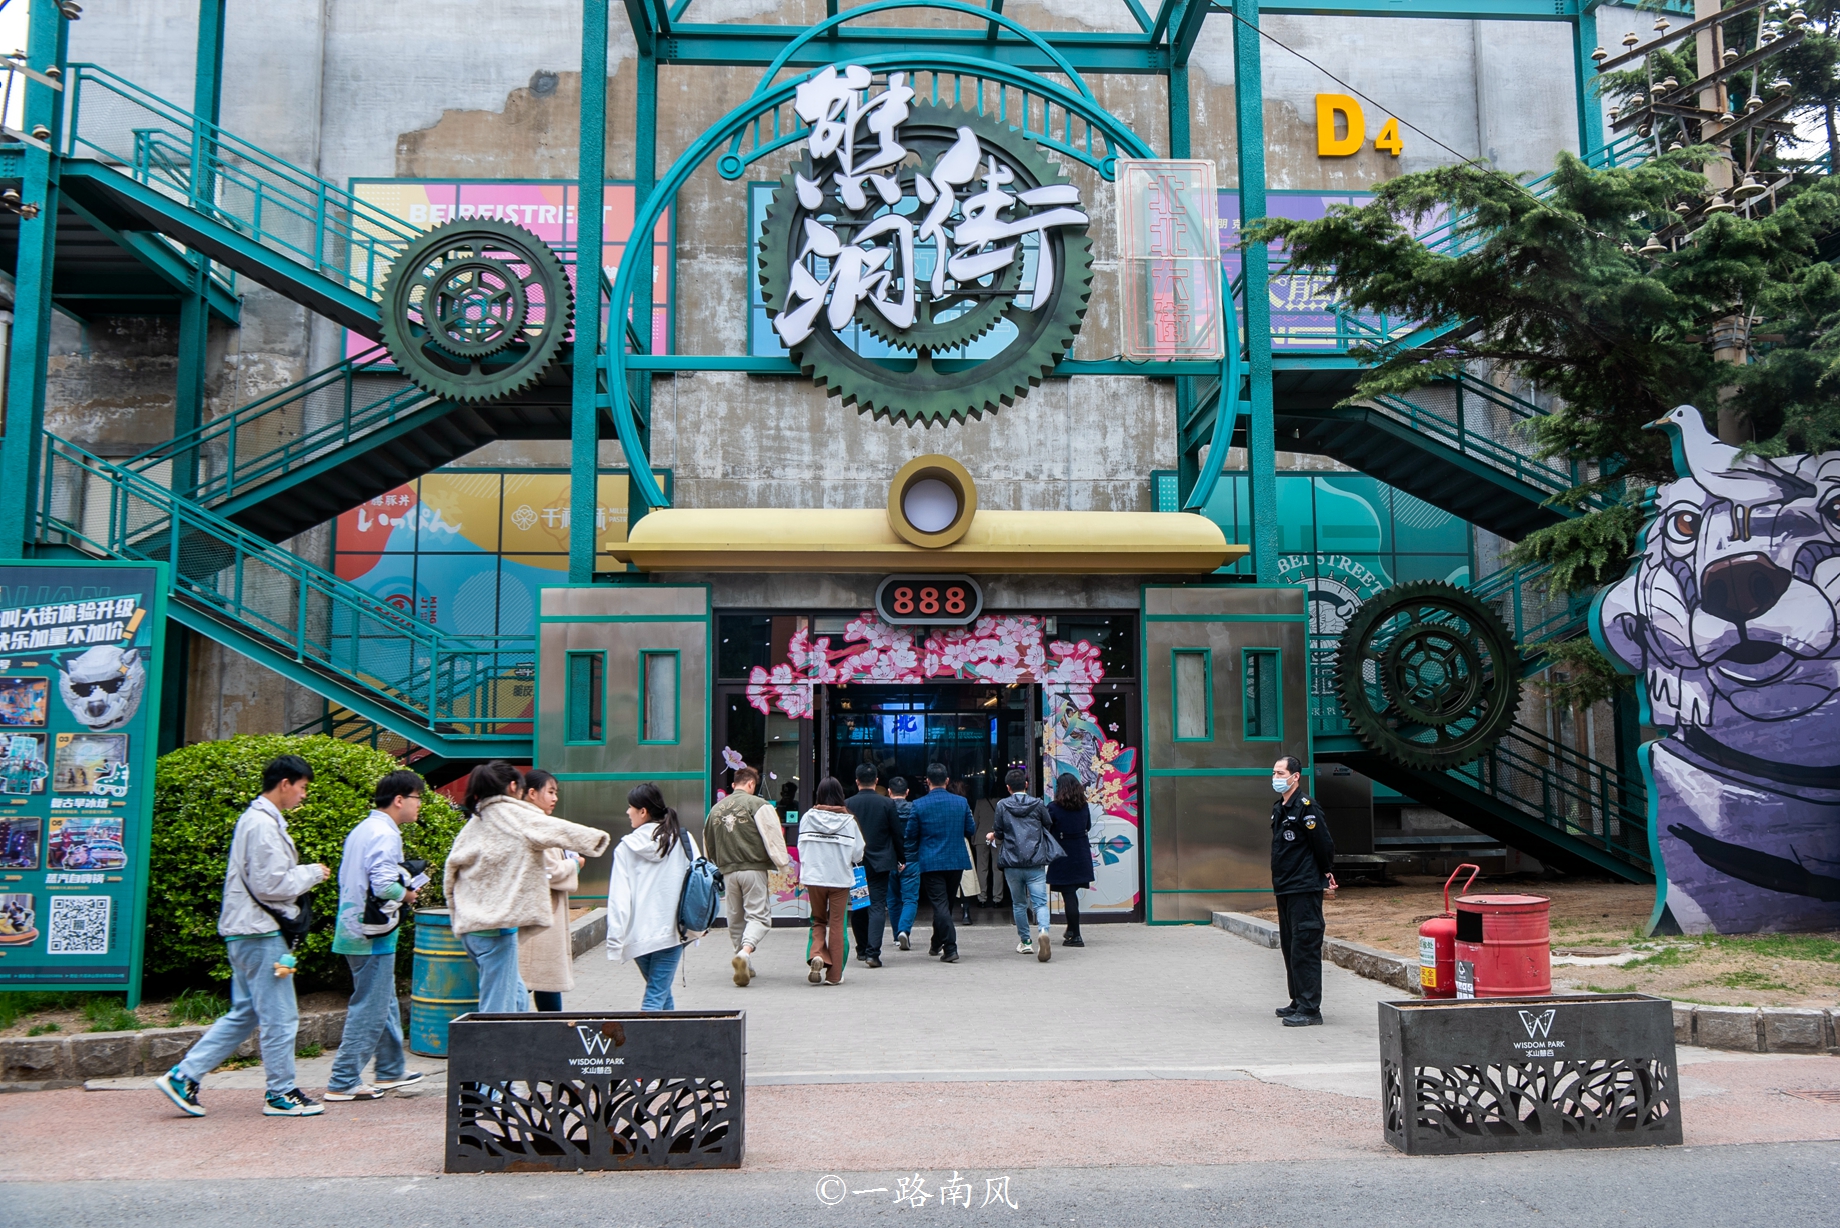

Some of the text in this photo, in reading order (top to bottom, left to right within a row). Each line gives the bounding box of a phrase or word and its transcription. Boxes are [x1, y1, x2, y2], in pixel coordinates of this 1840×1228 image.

[409, 204, 612, 224] BEIBEISTRET
[772, 65, 1090, 347] 熊洞街
[1148, 174, 1191, 344] 北北大街
[893, 587, 966, 614] 888
